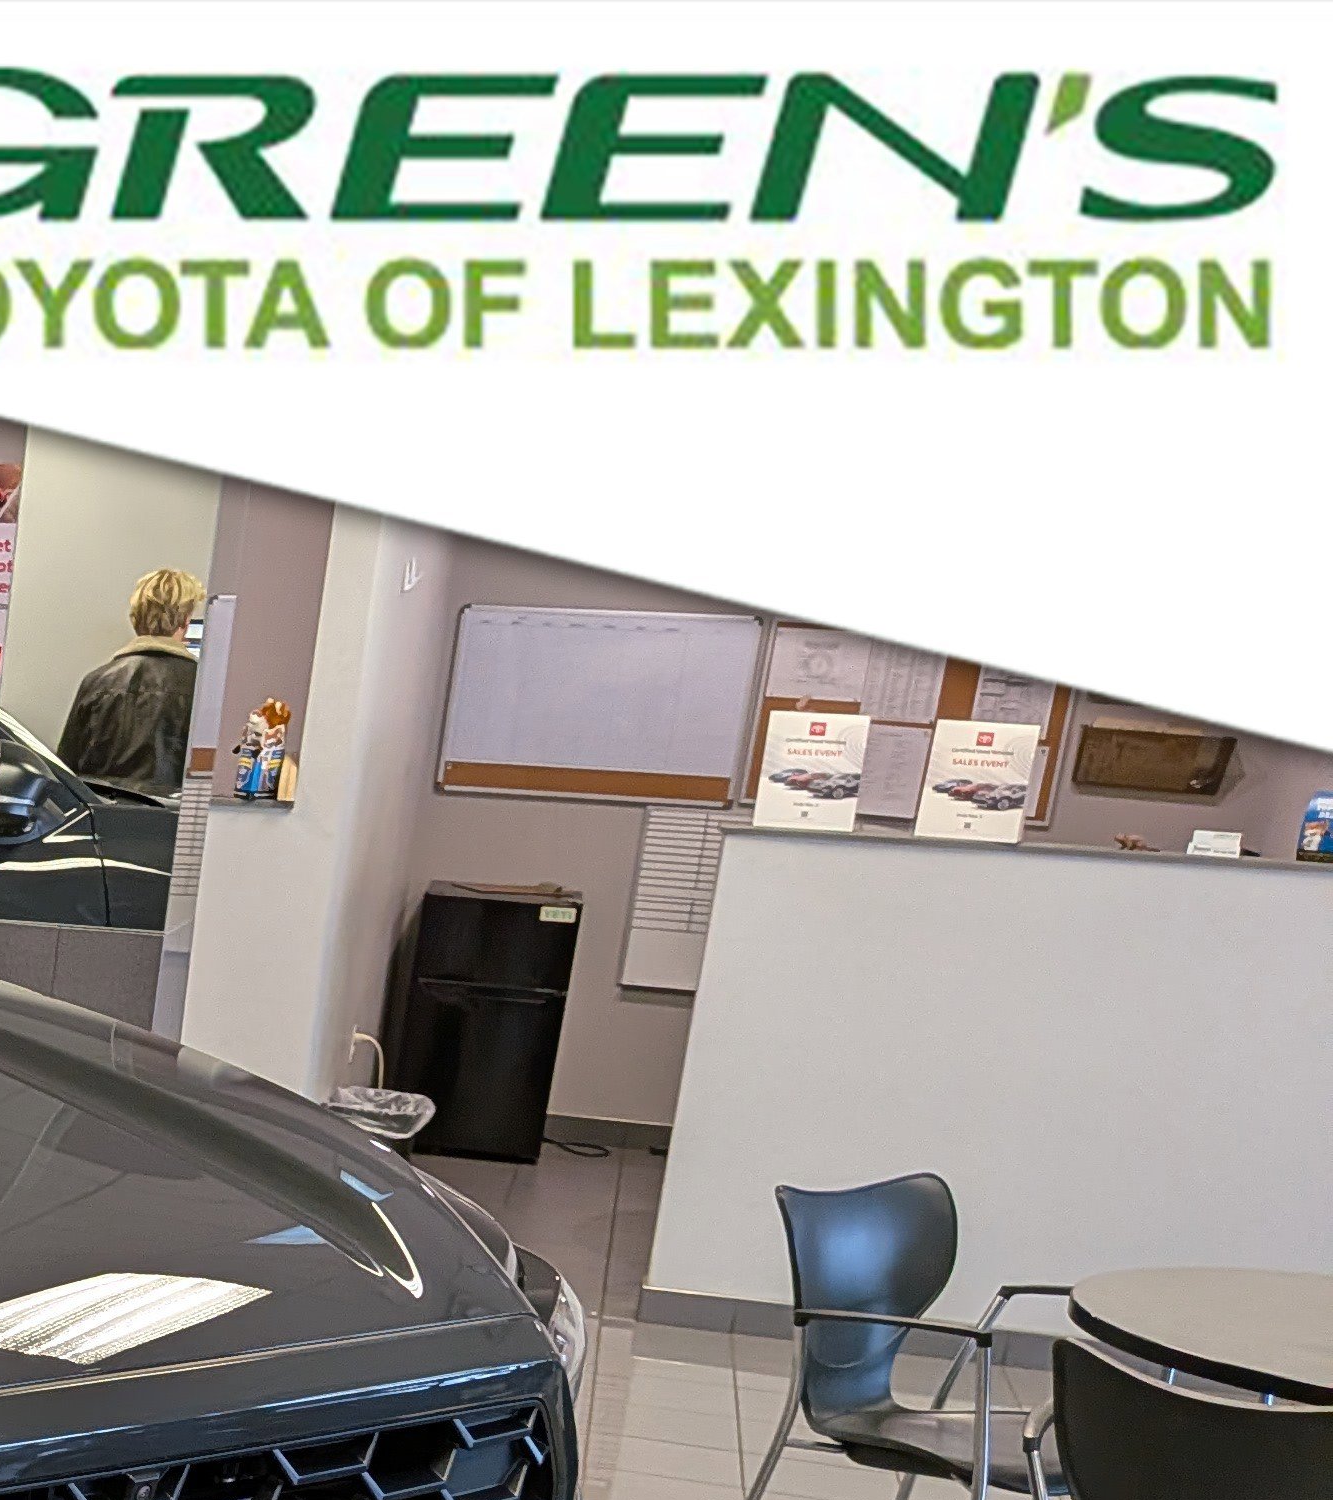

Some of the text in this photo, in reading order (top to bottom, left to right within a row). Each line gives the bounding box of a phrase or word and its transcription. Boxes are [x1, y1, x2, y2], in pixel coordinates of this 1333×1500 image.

[787, 747, 843, 758] SALES EVENT
[951, 758, 1010, 769] SALES EVENT
